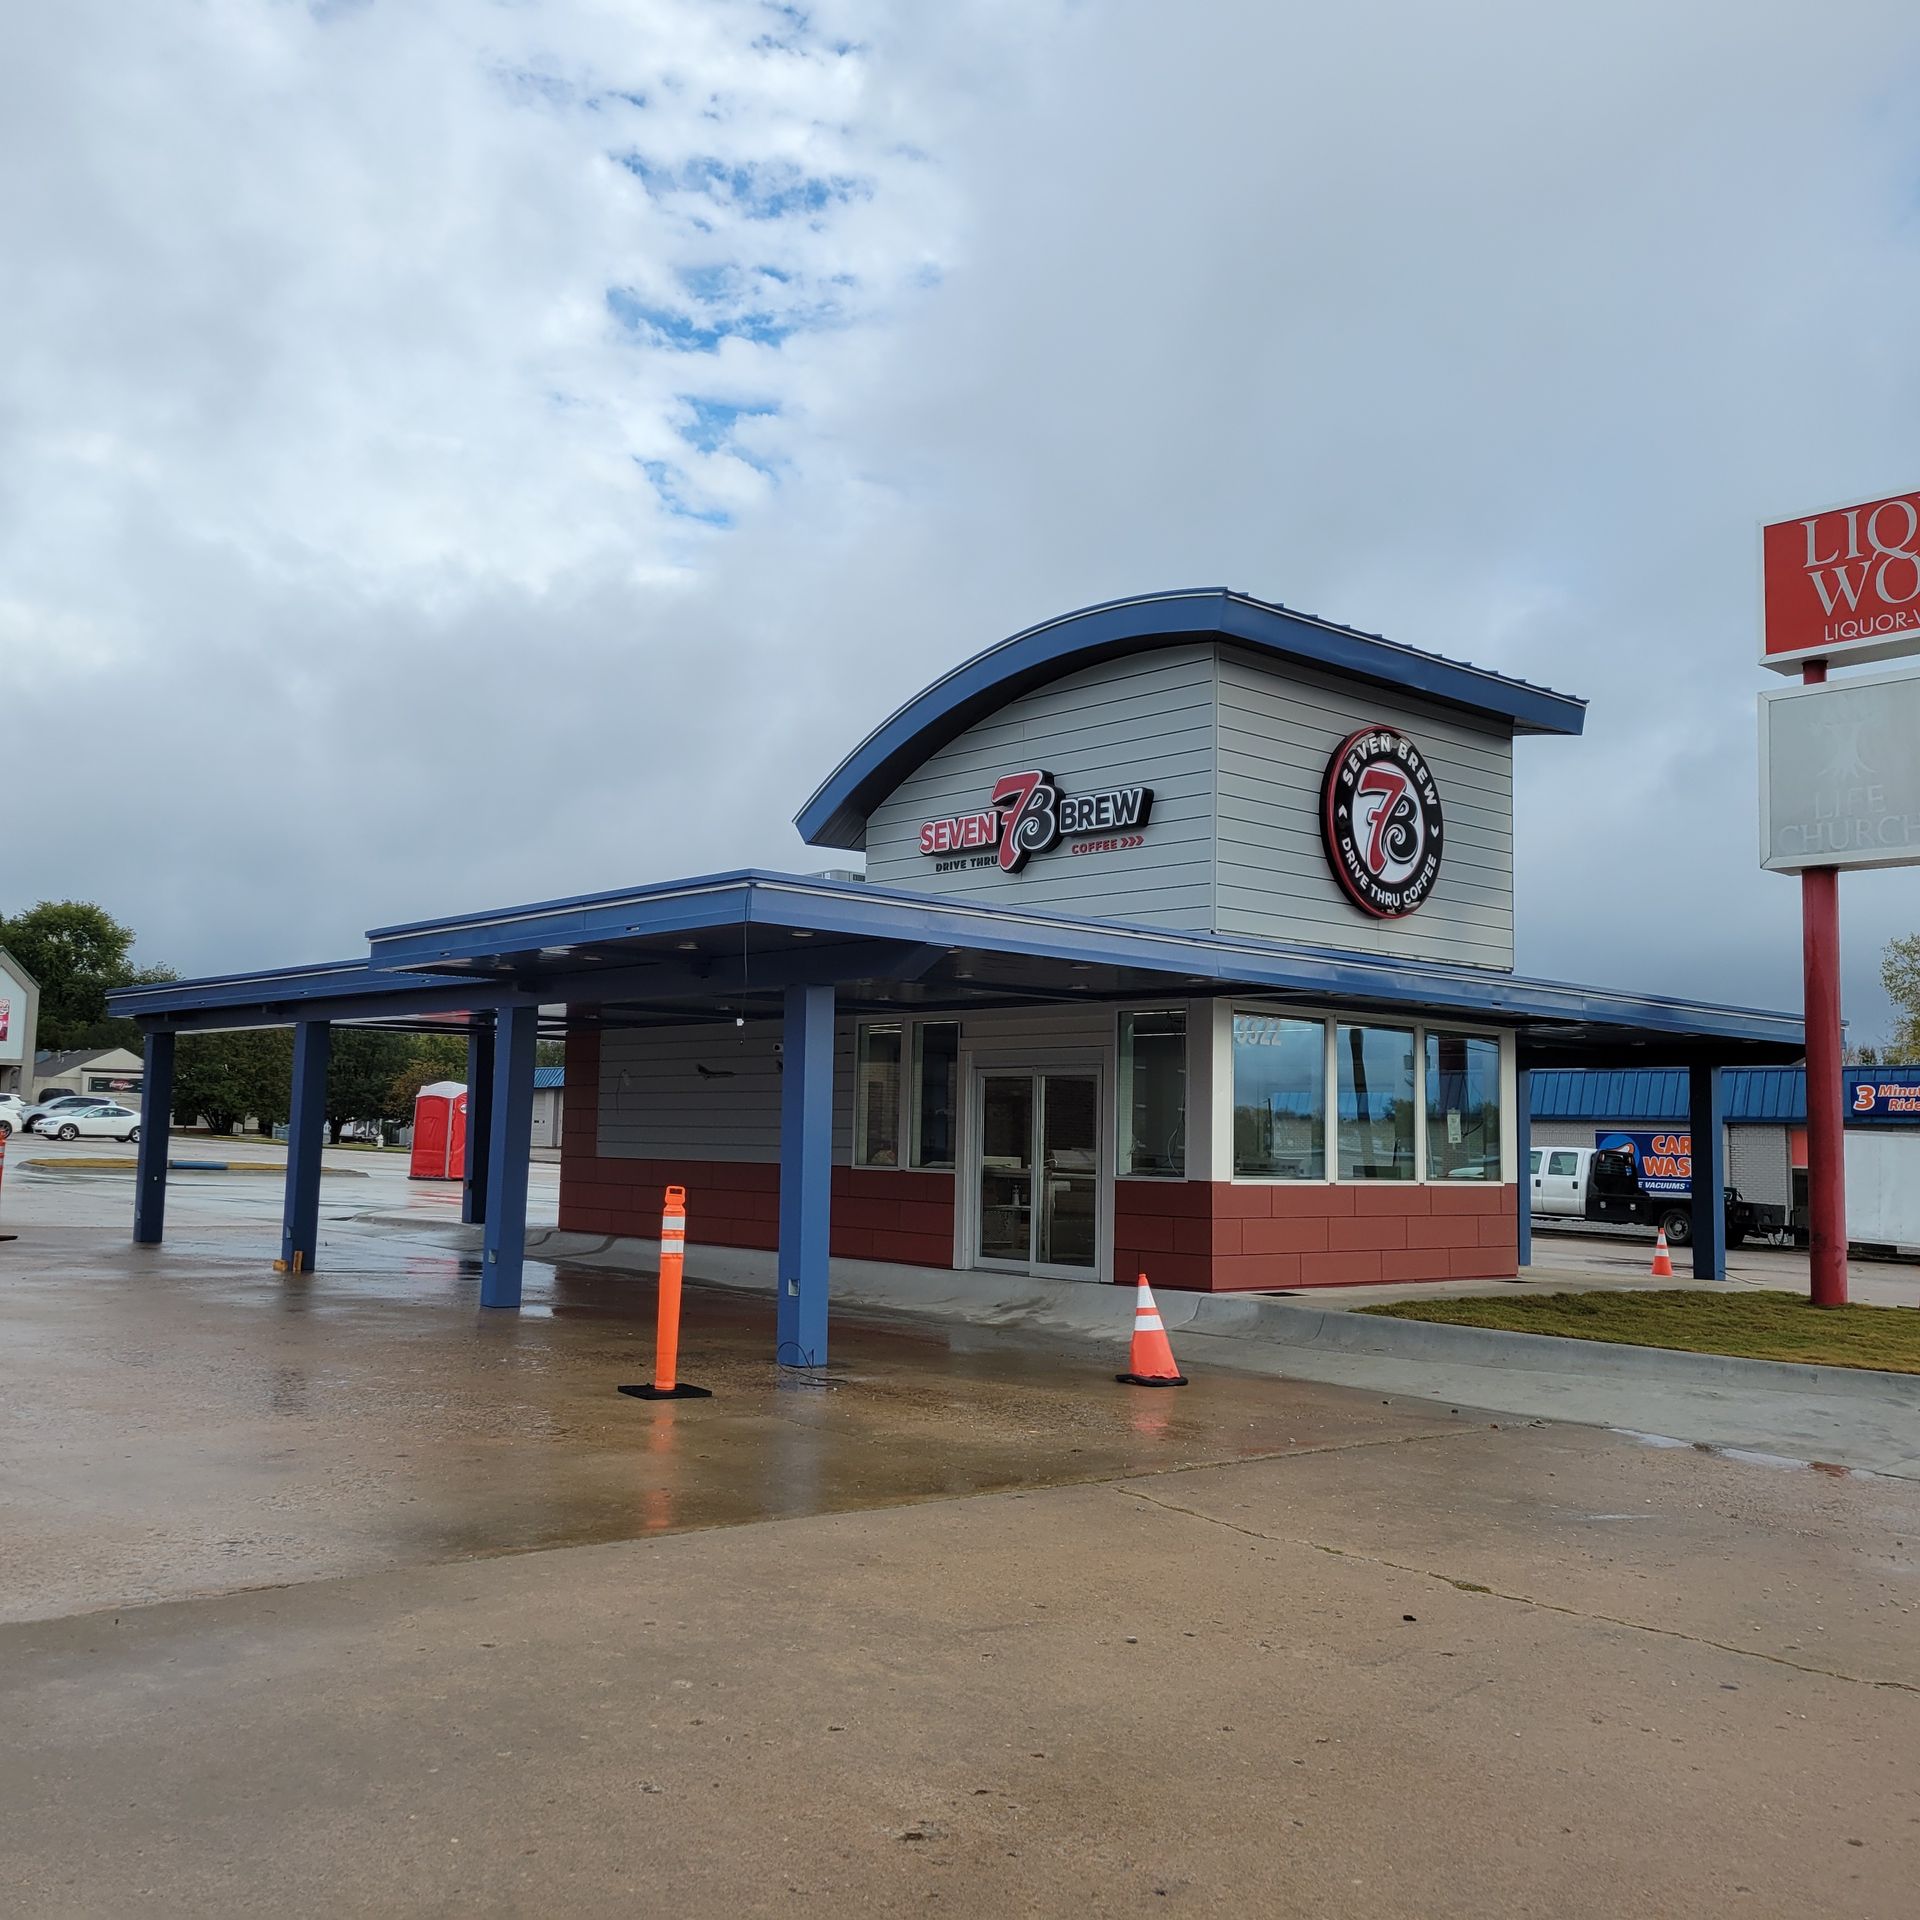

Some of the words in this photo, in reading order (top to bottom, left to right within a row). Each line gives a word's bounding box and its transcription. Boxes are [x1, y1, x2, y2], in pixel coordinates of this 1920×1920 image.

[1800, 496, 1920, 568] LIQ
[1808, 554, 1920, 617] WO
[1825, 608, 1920, 641] LIQUOR-
[1342, 735, 1391, 787] SEVEN
[1398, 743, 1437, 806] BREW
[1814, 784, 1887, 820] LIFE
[920, 811, 997, 854] SEVEN
[1059, 787, 1144, 834] BREW
[1071, 838, 1118, 855] COFFEE
[935, 859, 967, 873] DRIVE
[970, 855, 998, 868] THRU
[1342, 837, 1369, 889] DRIVE
[1371, 883, 1400, 907] THRU
[1403, 853, 1437, 904] COFFEE
[1853, 1084, 1876, 1111] 3
[1652, 1135, 1691, 1156] CAR
[1643, 1156, 1691, 1178] WAS
[1645, 1181, 1686, 1190] VACUUMS
